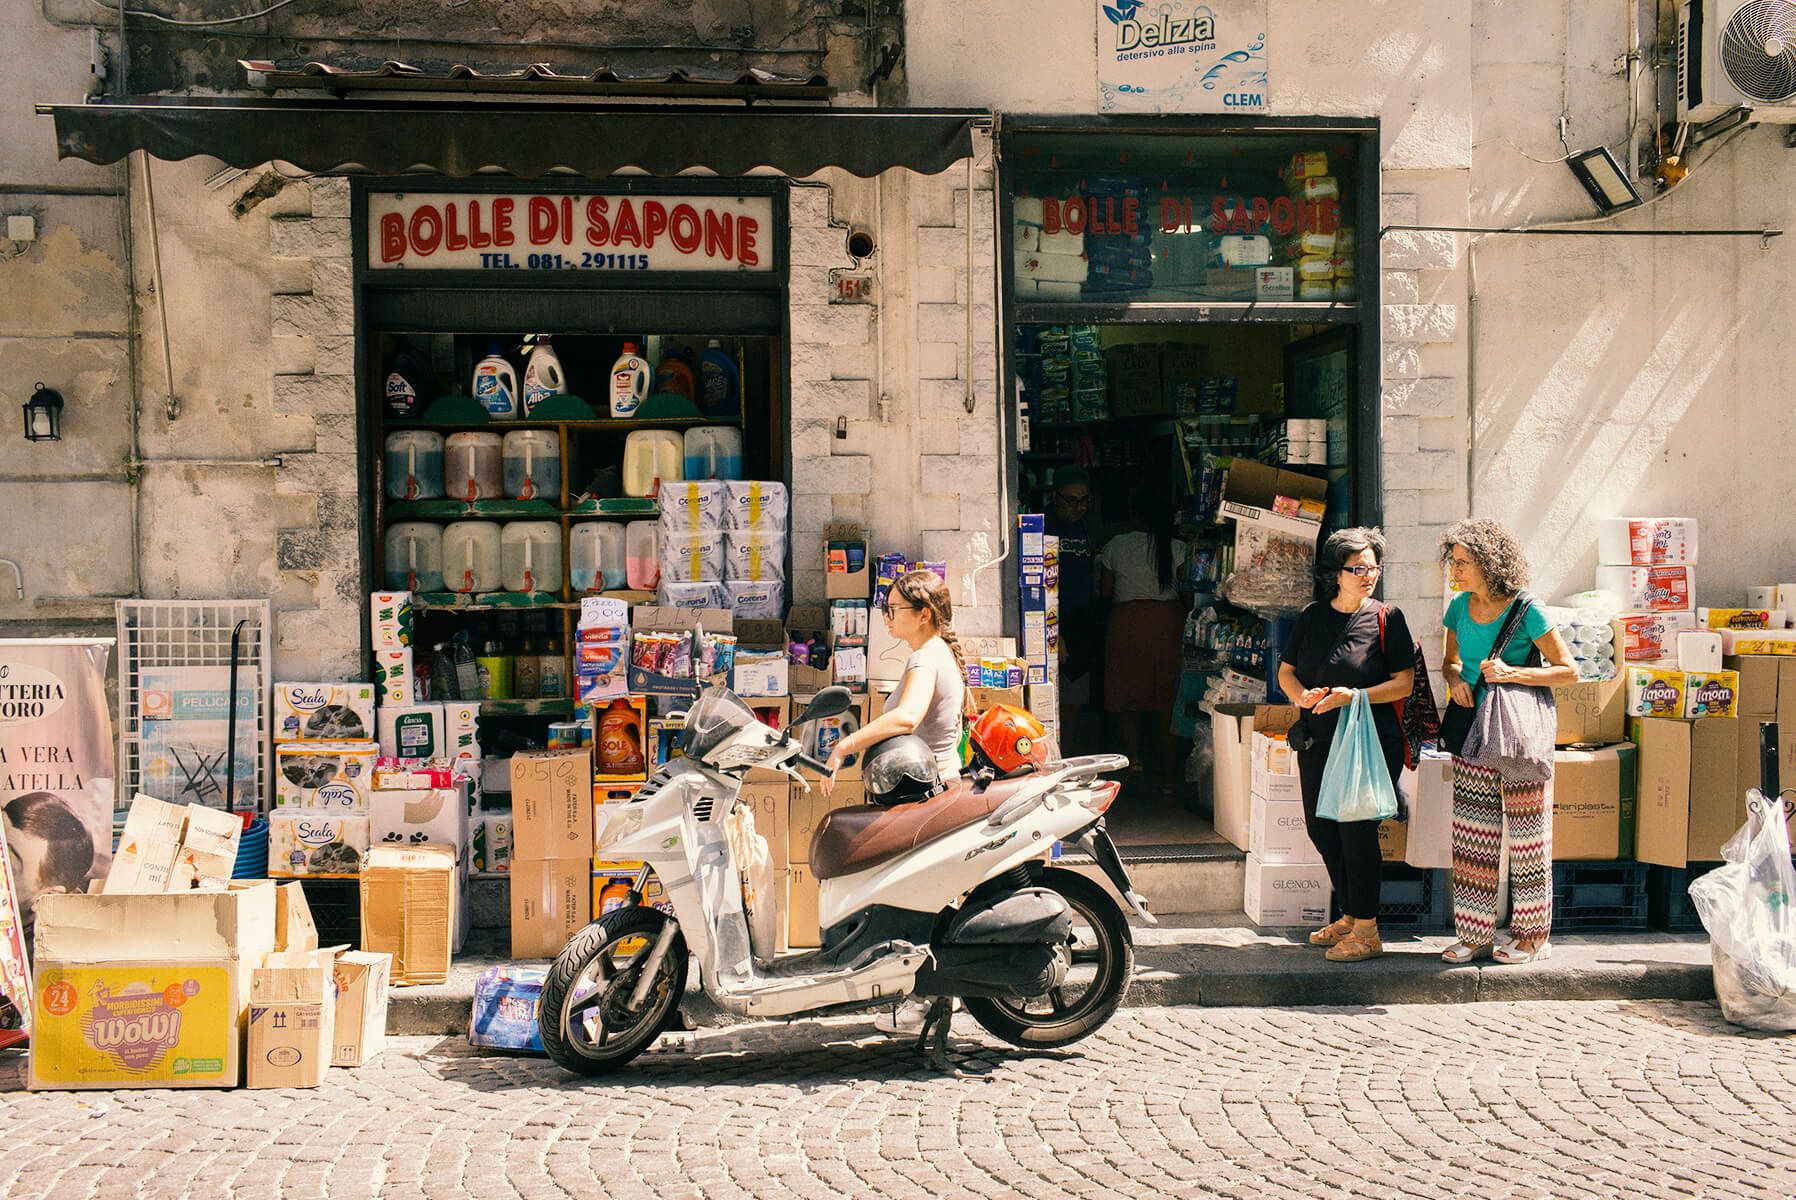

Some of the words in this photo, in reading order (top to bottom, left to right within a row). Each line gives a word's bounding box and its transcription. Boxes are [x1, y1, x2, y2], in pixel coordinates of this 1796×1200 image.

[1116, 14, 1216, 52] Delizia
[1116, 48, 1165, 62] detersivo
[1167, 45, 1186, 56] alla
[1188, 42, 1217, 55] spina
[1223, 93, 1263, 106] CLEM
[1042, 195, 1140, 236] BOLLE
[1160, 196, 1192, 236] DI
[1211, 195, 1342, 236] SAPONE
[381, 197, 515, 264] BOLLE
[528, 196, 573, 246] DI
[585, 196, 759, 266] SAPONE
[479, 252, 520, 269] TEL.
[580, 252, 649, 270] 291115
[387, 382, 407, 393] Soft
[675, 597, 707, 608] Corona
[737, 594, 768, 604] Corona
[584, 632, 609, 640] vileda
[182, 696, 249, 707] PELLICAO
[290, 688, 327, 706] Scala
[601, 740, 628, 751] SOLE
[21, 746, 73, 763] VERA
[320, 786, 354, 807] Scala
[298, 822, 335, 841] Scala
[1272, 879, 1321, 890] GLENOVA
[50, 989, 70, 1008] 24
